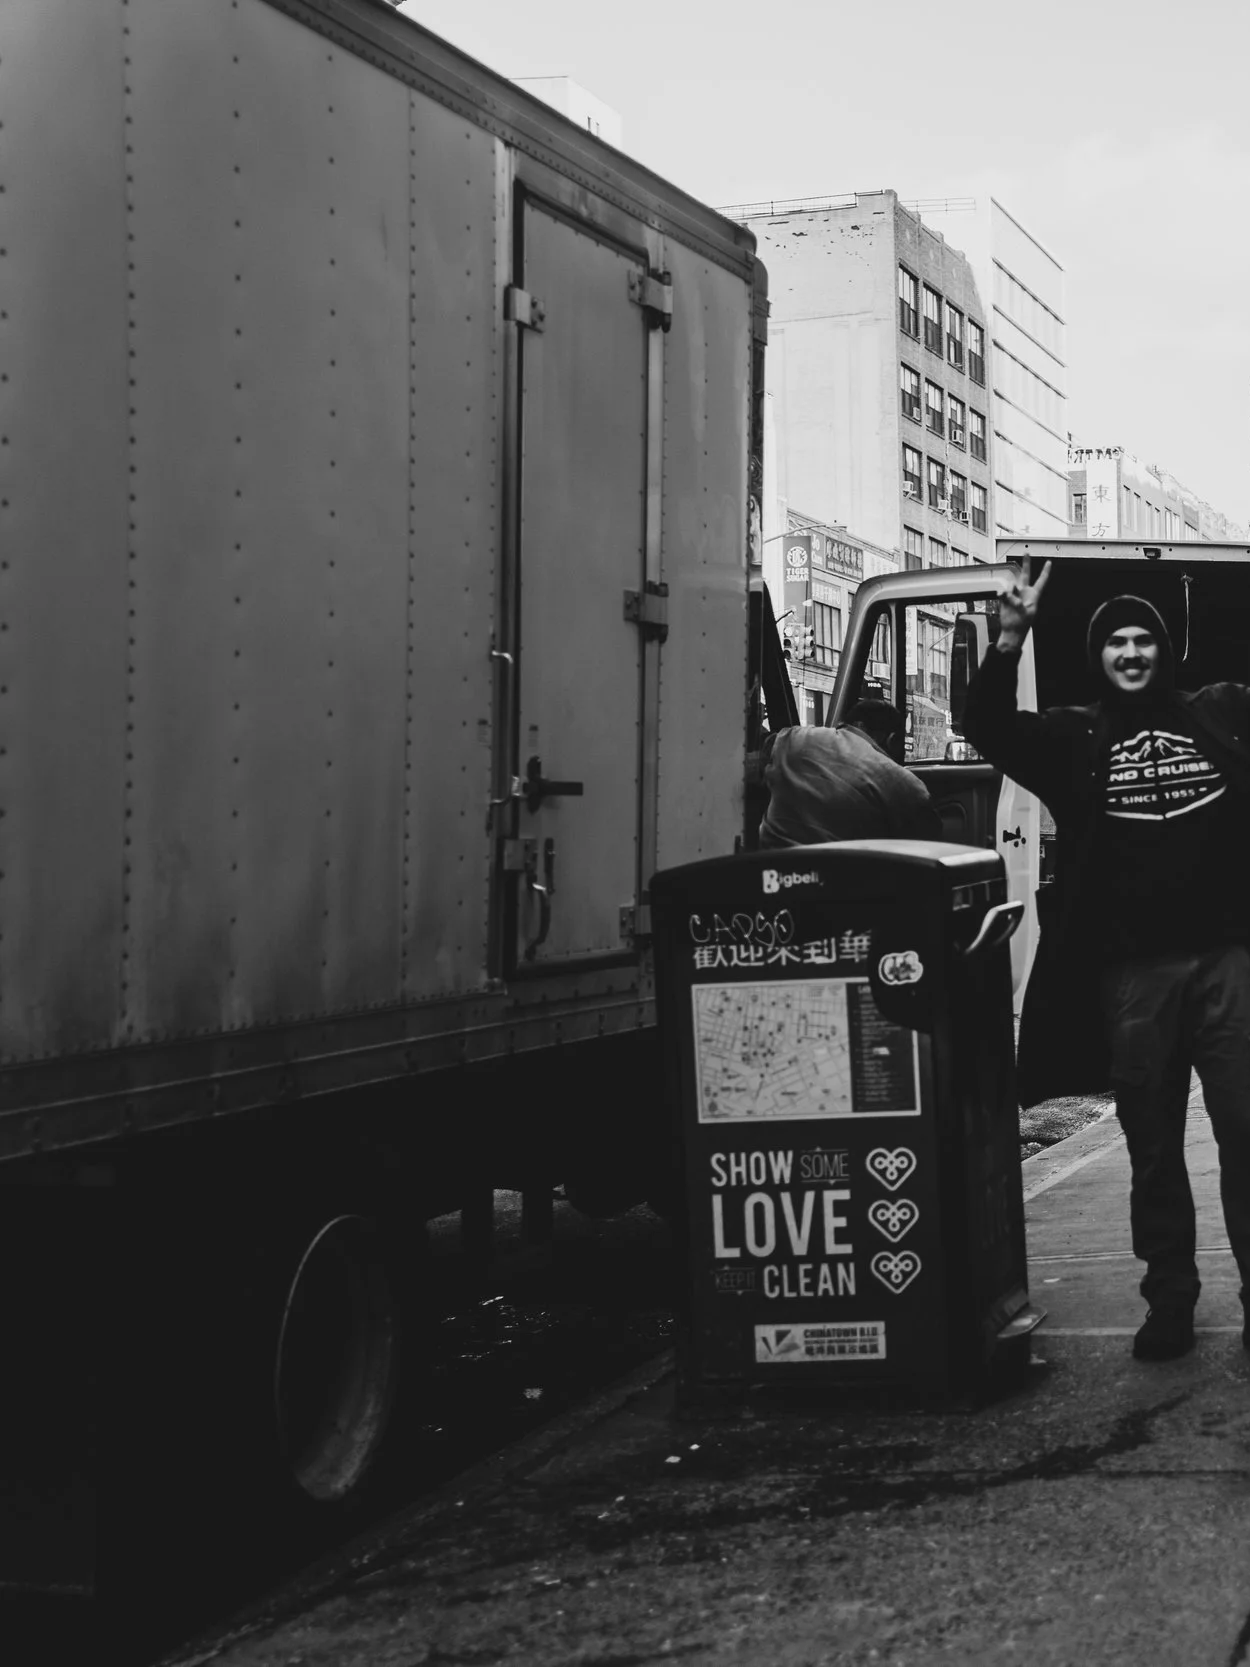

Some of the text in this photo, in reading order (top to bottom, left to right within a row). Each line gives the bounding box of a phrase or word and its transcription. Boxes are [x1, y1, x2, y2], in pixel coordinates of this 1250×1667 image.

[786, 574, 810, 582] SUGAR
[1109, 770, 1138, 782] ND
[1121, 788, 1196, 804] SINCE 1955
[710, 1150, 850, 1187] SHOW SOME
[712, 1189, 854, 1258] LOVE
[764, 1262, 856, 1298] CLEAN
[804, 1327, 857, 1338] CHINATOWN
